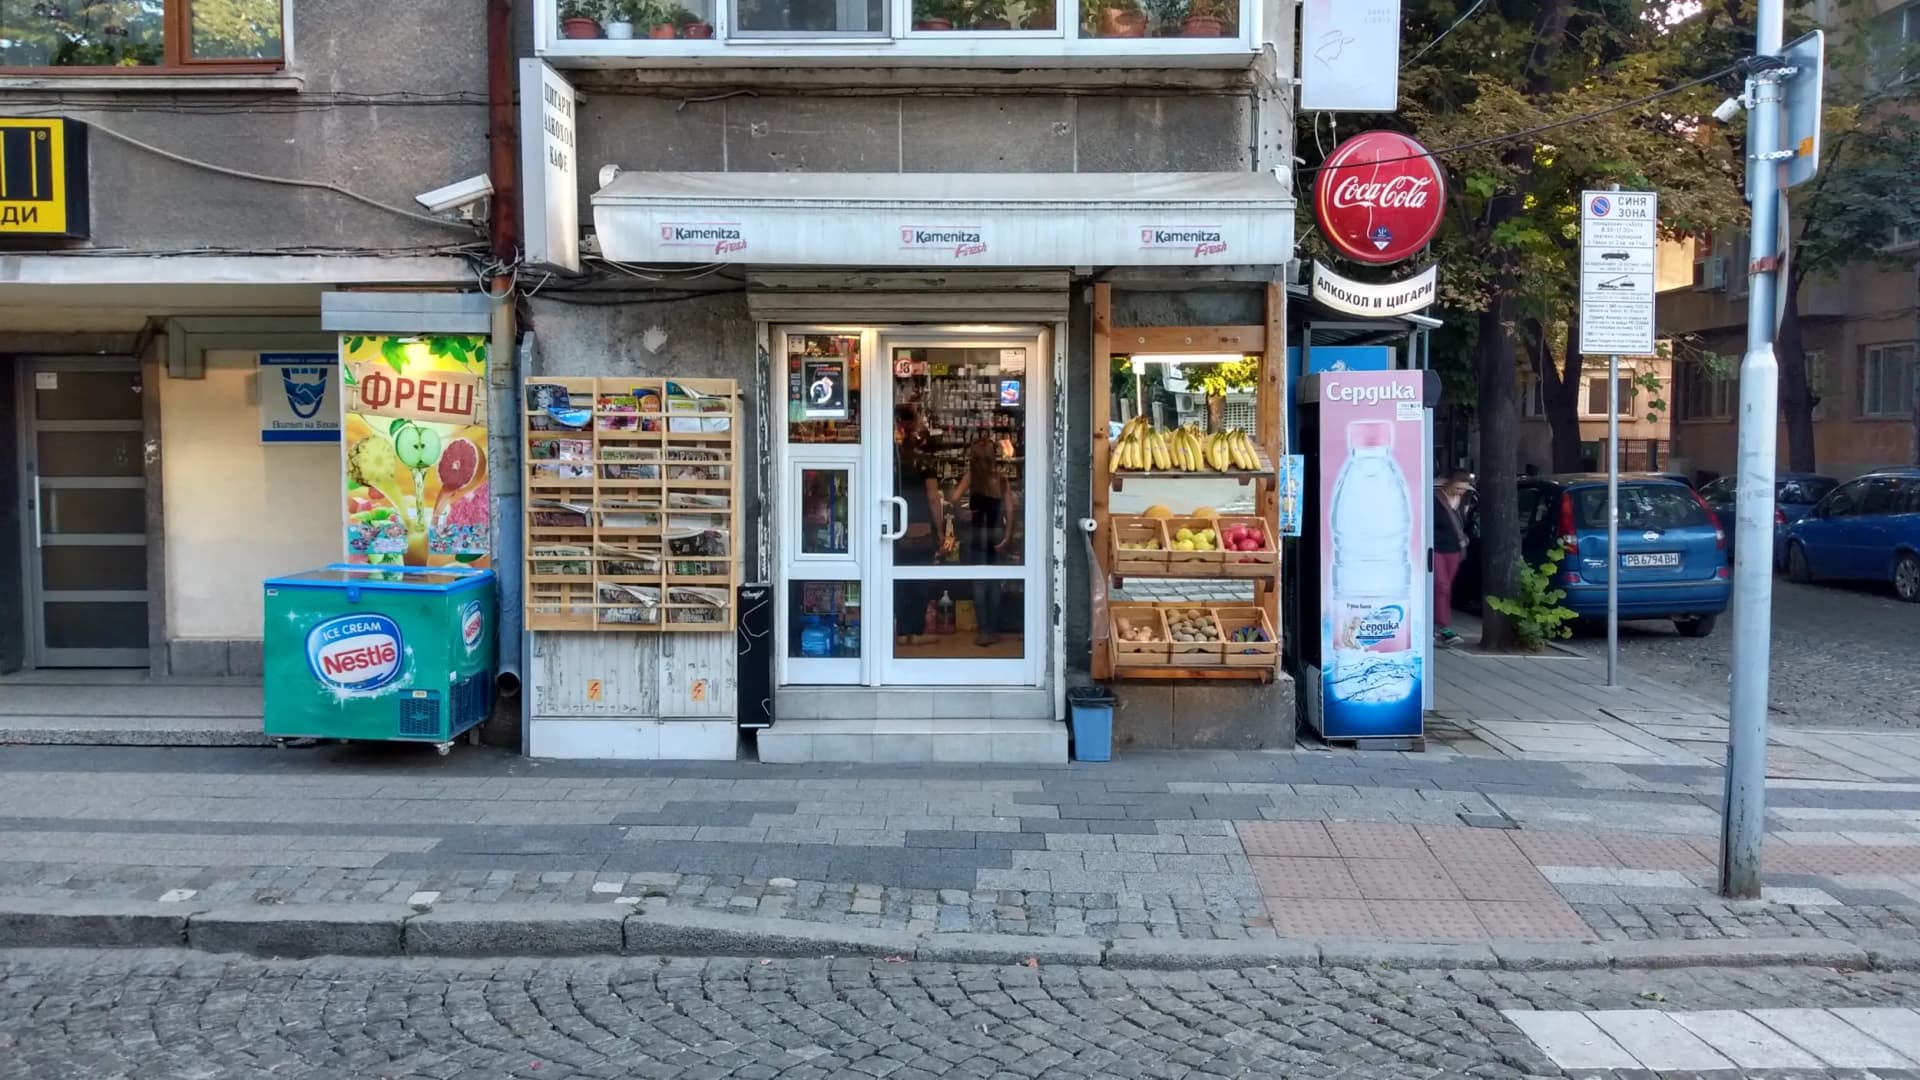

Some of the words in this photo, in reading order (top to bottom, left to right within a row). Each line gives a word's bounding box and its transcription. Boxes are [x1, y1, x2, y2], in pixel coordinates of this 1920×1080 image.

[544, 82, 571, 119] ЦИГАРИ
[544, 112, 574, 148] АЛКОХОЛ
[549, 145, 568, 173] КАФЕ
[1333, 175, 1434, 208] Coca-Cola
[1617, 196, 1647, 206] СИНЯ
[1618, 208, 1647, 218] ЗОНА
[675, 227, 741, 241] Kamenitza
[915, 230, 981, 244] Kamenitza
[1155, 230, 1221, 243] Kamenitza
[715, 238, 747, 255] Fresh
[955, 241, 988, 258] Fresh
[1193, 240, 1228, 258] Fresh
[1317, 276, 1369, 308] АЛКОХОЛ
[1373, 297, 1382, 308] И
[1386, 281, 1433, 308] ЦИГАРИ
[361, 371, 474, 416] ФРЕШ
[1326, 380, 1416, 406] Сердика
[322, 627, 341, 641] ICE
[342, 621, 382, 635] CREAM
[1360, 619, 1400, 634] Сердика
